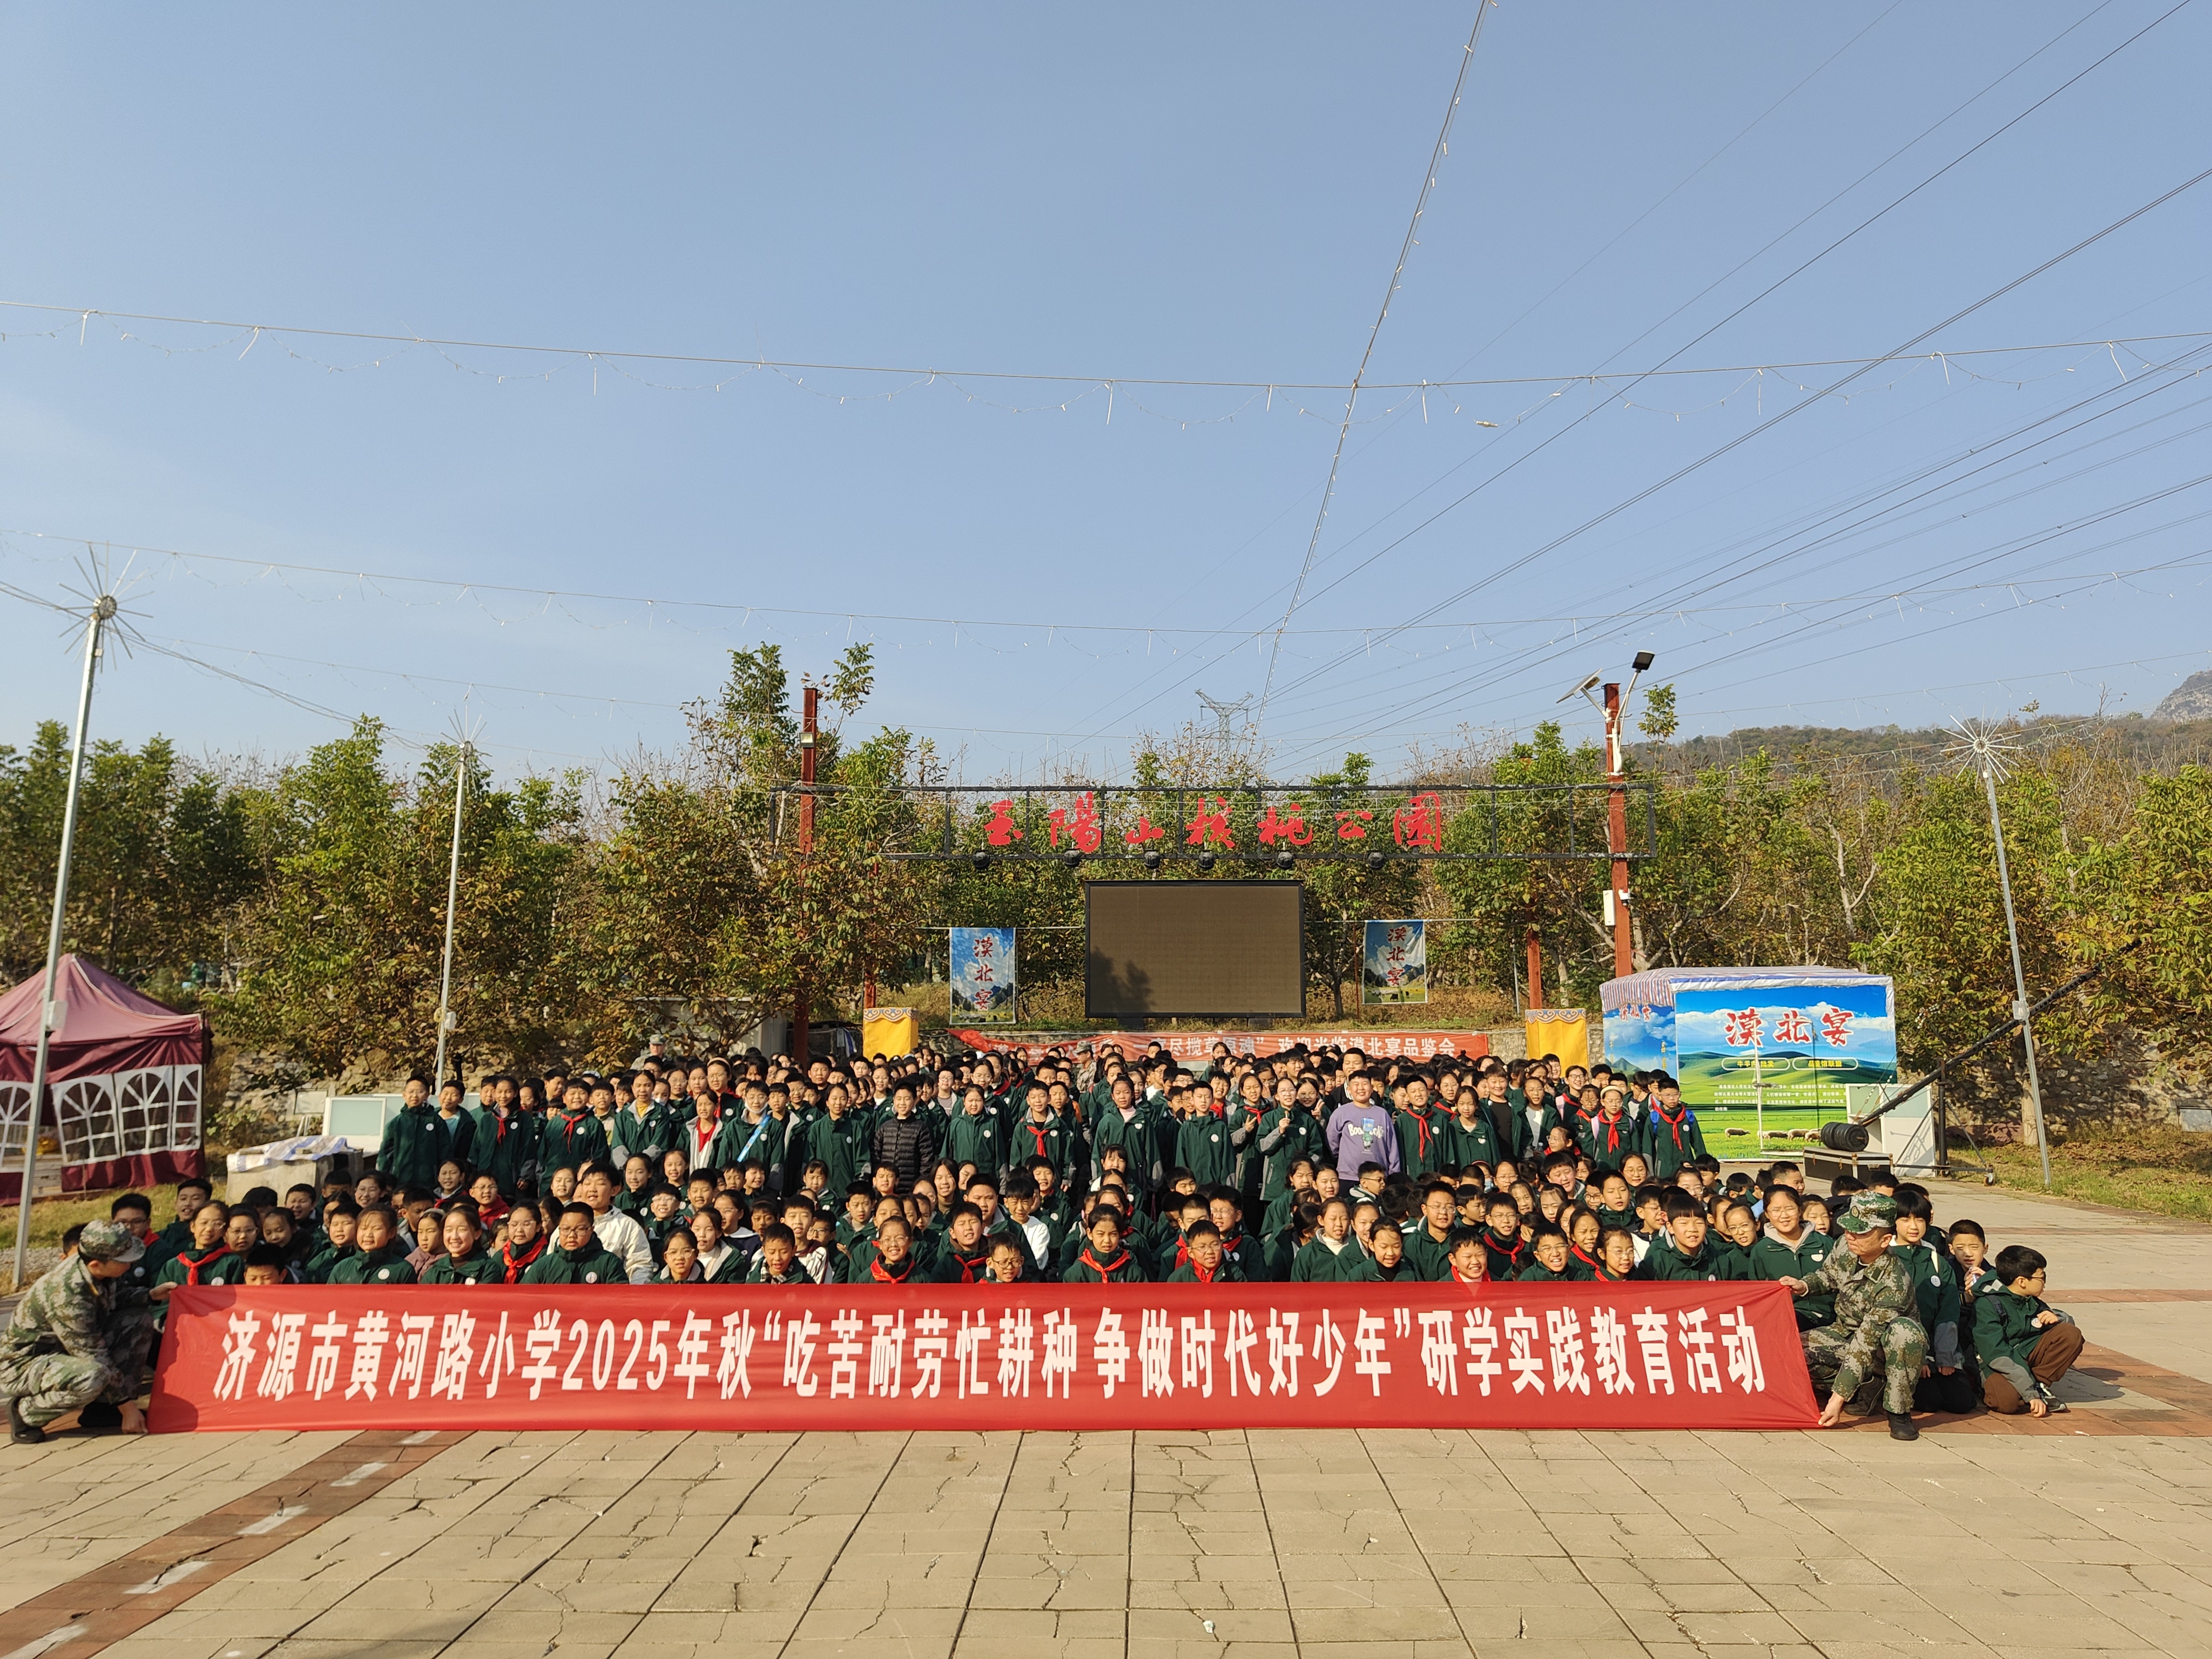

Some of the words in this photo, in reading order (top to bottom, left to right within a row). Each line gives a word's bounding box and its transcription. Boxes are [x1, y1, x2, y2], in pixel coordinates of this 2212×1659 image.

[973, 936, 994, 1010] 漠北宴
[1386, 927, 1407, 986] 漠北宴
[1724, 1006, 1854, 1046] 漠北宴
[213, 1307, 1077, 1402] 济源市黄河路小学2025年秋“吃苦耐劳忙耕种
[1094, 1306, 1765, 1399] 争做时代好少年”研学实践教育活动
